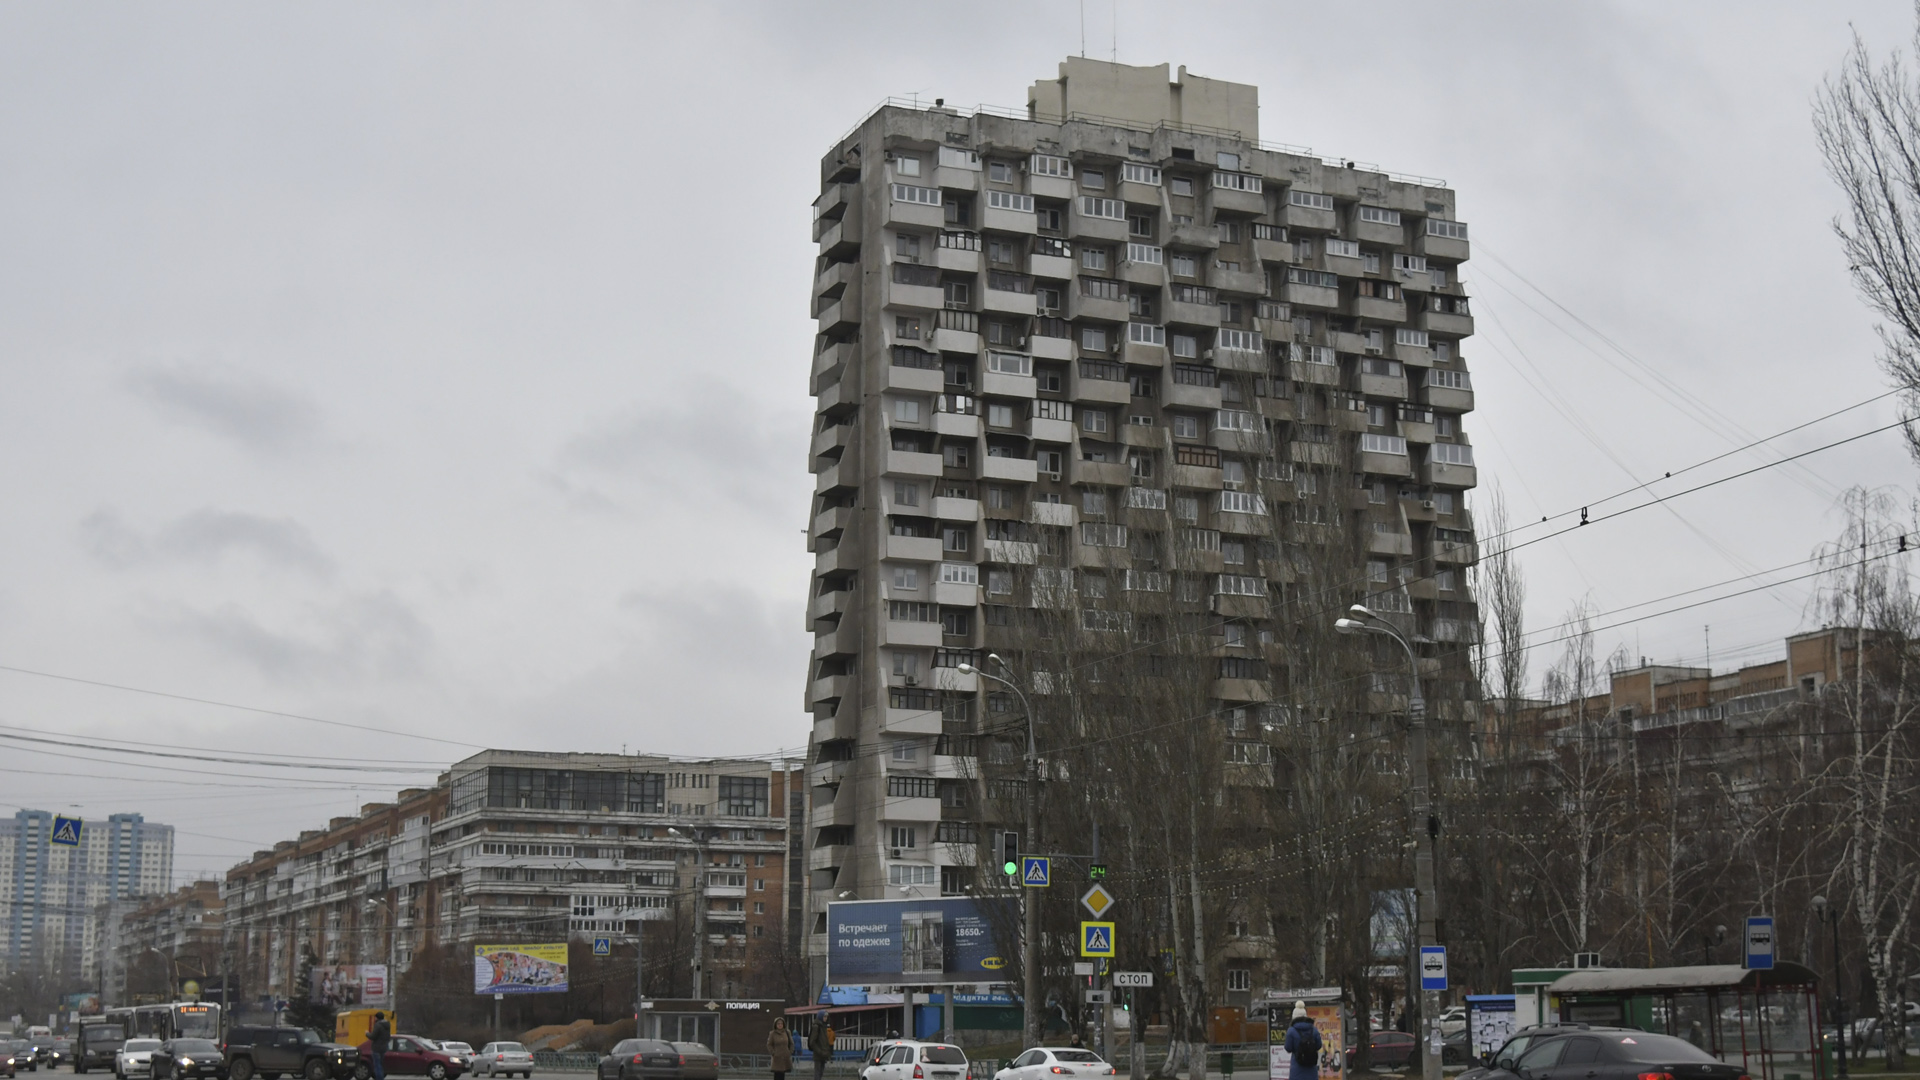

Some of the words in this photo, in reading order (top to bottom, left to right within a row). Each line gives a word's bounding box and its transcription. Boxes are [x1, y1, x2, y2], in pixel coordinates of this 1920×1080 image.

[1090, 866, 1106, 878] 24
[838, 923, 888, 935] Встречает
[955, 928, 985, 937] 18650.-
[838, 938, 851, 947] по
[852, 937, 891, 948] одежке
[1119, 975, 1148, 985] СТОП
[726, 1002, 760, 1010] ПОЛИЦИЯ
